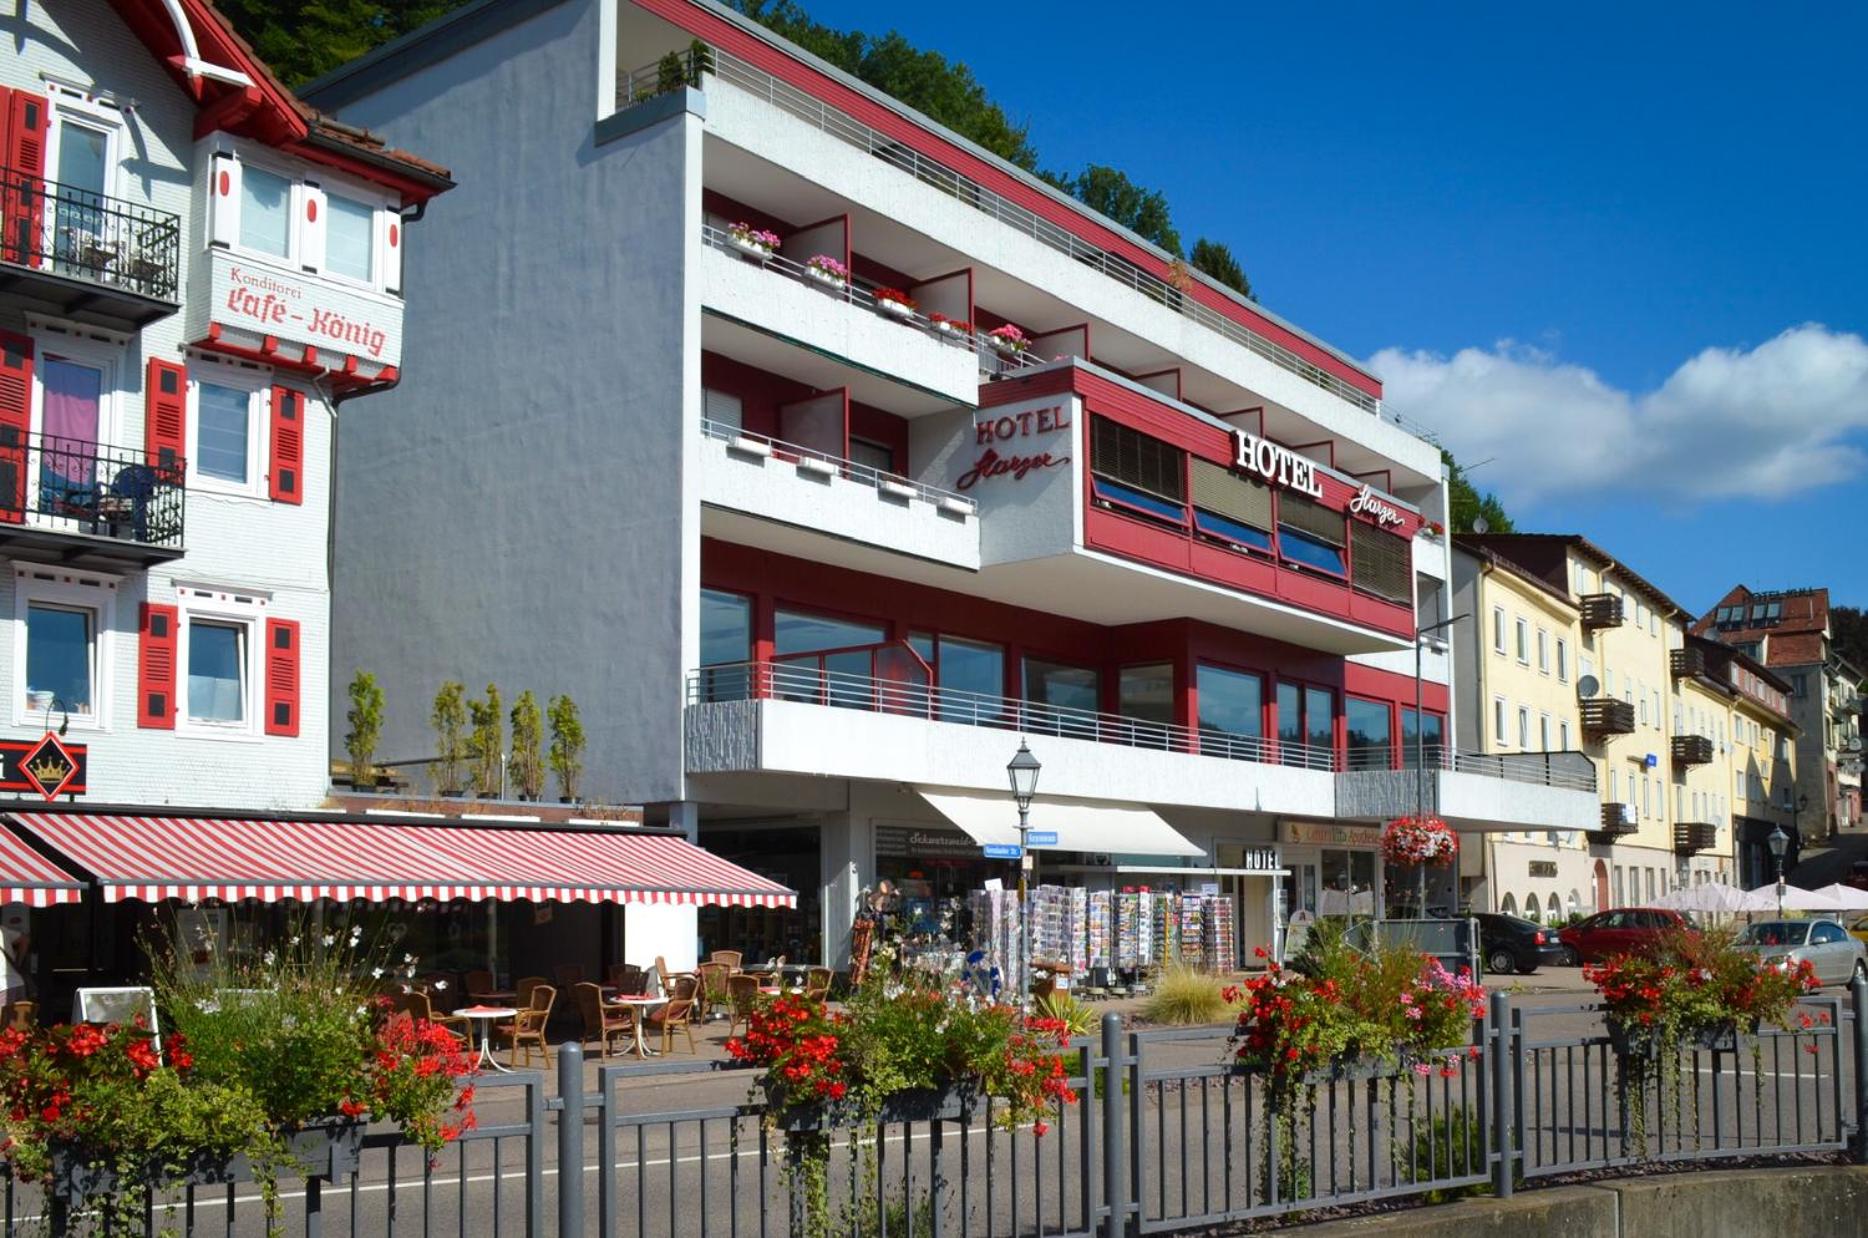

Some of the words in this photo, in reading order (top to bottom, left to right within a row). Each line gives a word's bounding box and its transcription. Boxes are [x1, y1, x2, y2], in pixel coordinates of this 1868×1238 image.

[230, 267, 302, 299] Konditorei
[976, 406, 1070, 445] HOTEL
[956, 448, 1071, 490] Harzer
[1236, 430, 1323, 498] HOTEL
[1350, 484, 1405, 526] Harzer
[1246, 850, 1281, 870] HOTEL
